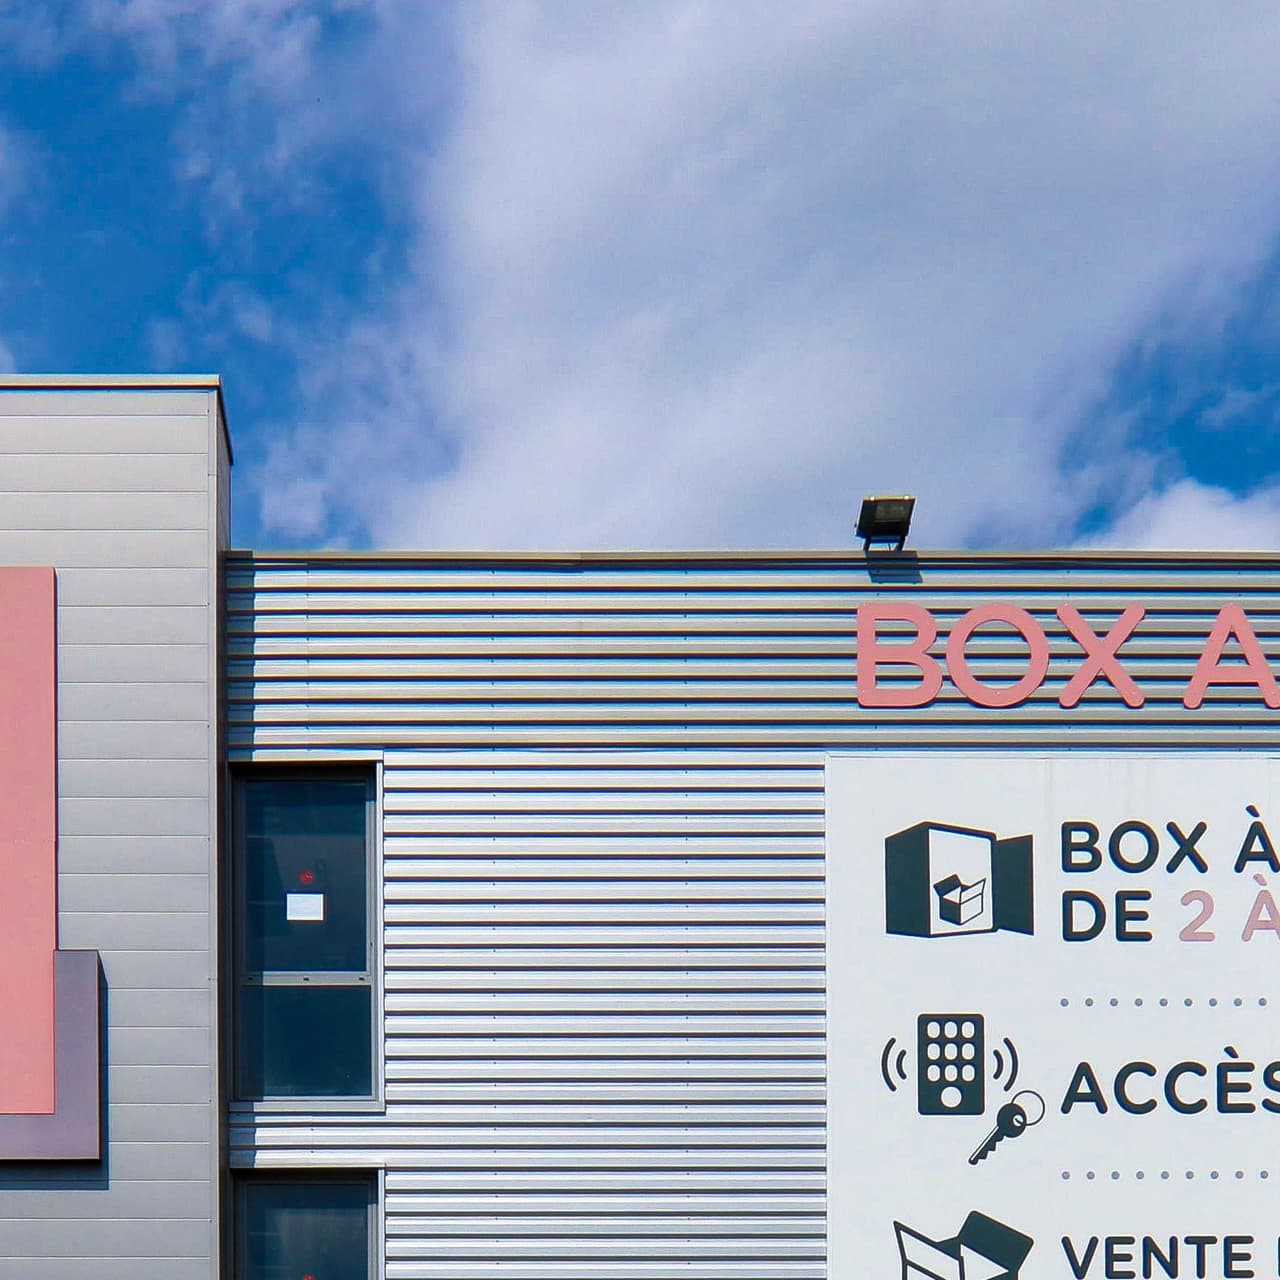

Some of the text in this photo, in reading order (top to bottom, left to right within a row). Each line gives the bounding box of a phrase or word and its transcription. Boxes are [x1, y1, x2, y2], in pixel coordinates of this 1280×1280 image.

[856, 602, 1146, 709] BOX
[1060, 820, 1207, 874] BOX
[1233, 805, 1280, 874] À
[1060, 890, 1153, 943] DE
[1178, 889, 1216, 943] 2
[1061, 1235, 1255, 1280] VENTE
